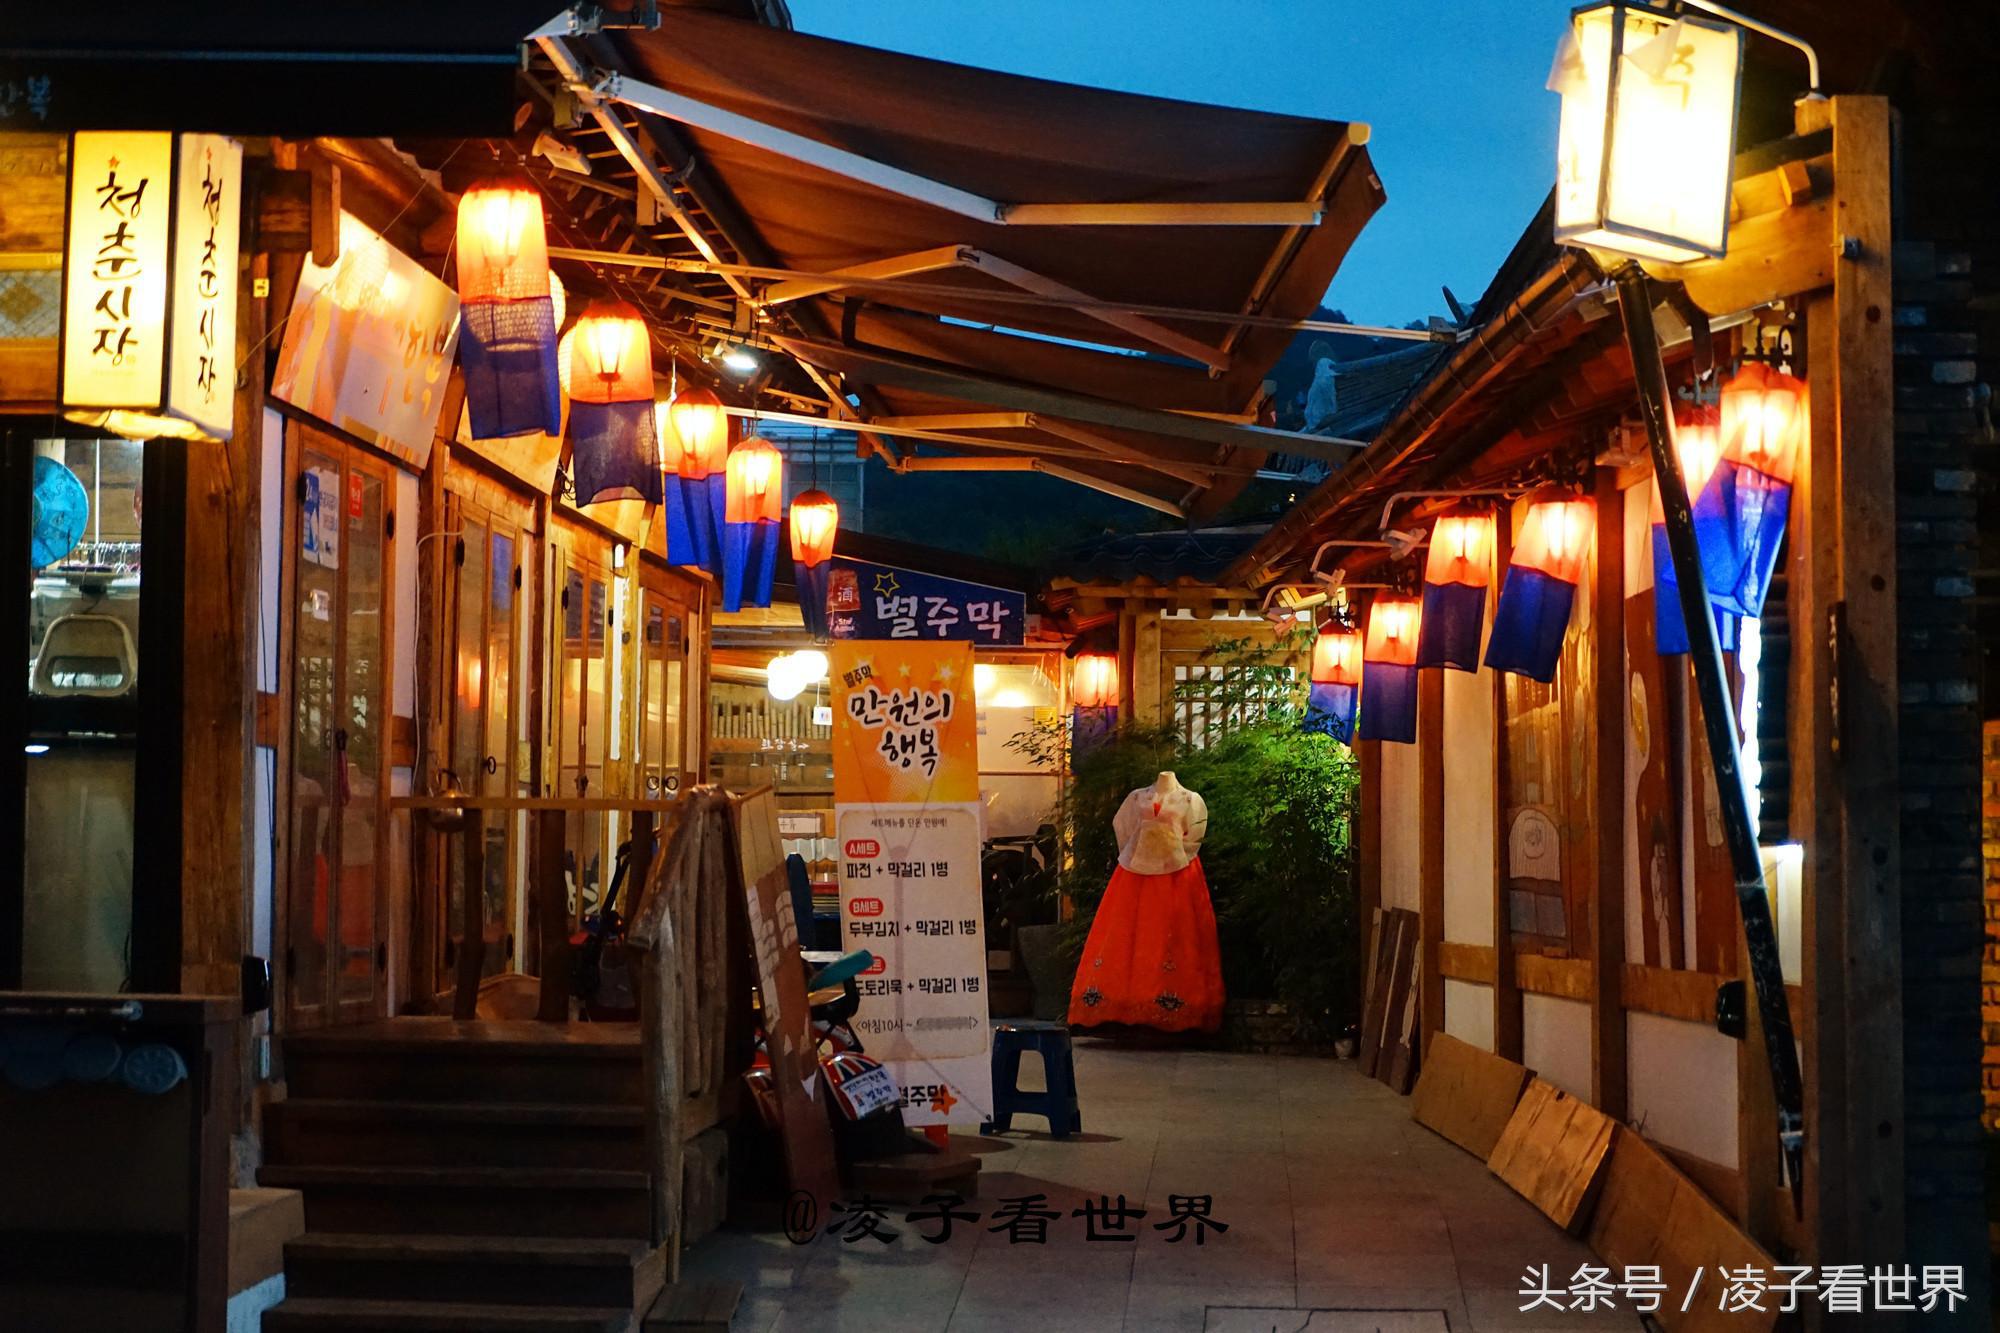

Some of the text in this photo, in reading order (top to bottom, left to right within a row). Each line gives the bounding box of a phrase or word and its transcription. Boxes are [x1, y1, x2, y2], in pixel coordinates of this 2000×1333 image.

[93, 171, 148, 367] 청춘시장
[198, 164, 222, 404] 청춘시장
[837, 586, 853, 602] 酒
[876, 596, 1010, 639] 별주막
[843, 665, 872, 688] 별주막
[851, 690, 951, 726] 만원의
[881, 727, 938, 777] 행복
[849, 841, 876, 855] A세트
[846, 863, 871, 878] 파전
[888, 862, 925, 877] 막걸리
[931, 861, 948, 877] 1병
[853, 901, 880, 914] B세트
[850, 921, 900, 937] 두부김치
[916, 920, 953, 935] 막걸리
[959, 920, 976, 935] 1병
[919, 978, 956, 994] 막걸리
[962, 976, 979, 993] 1병
